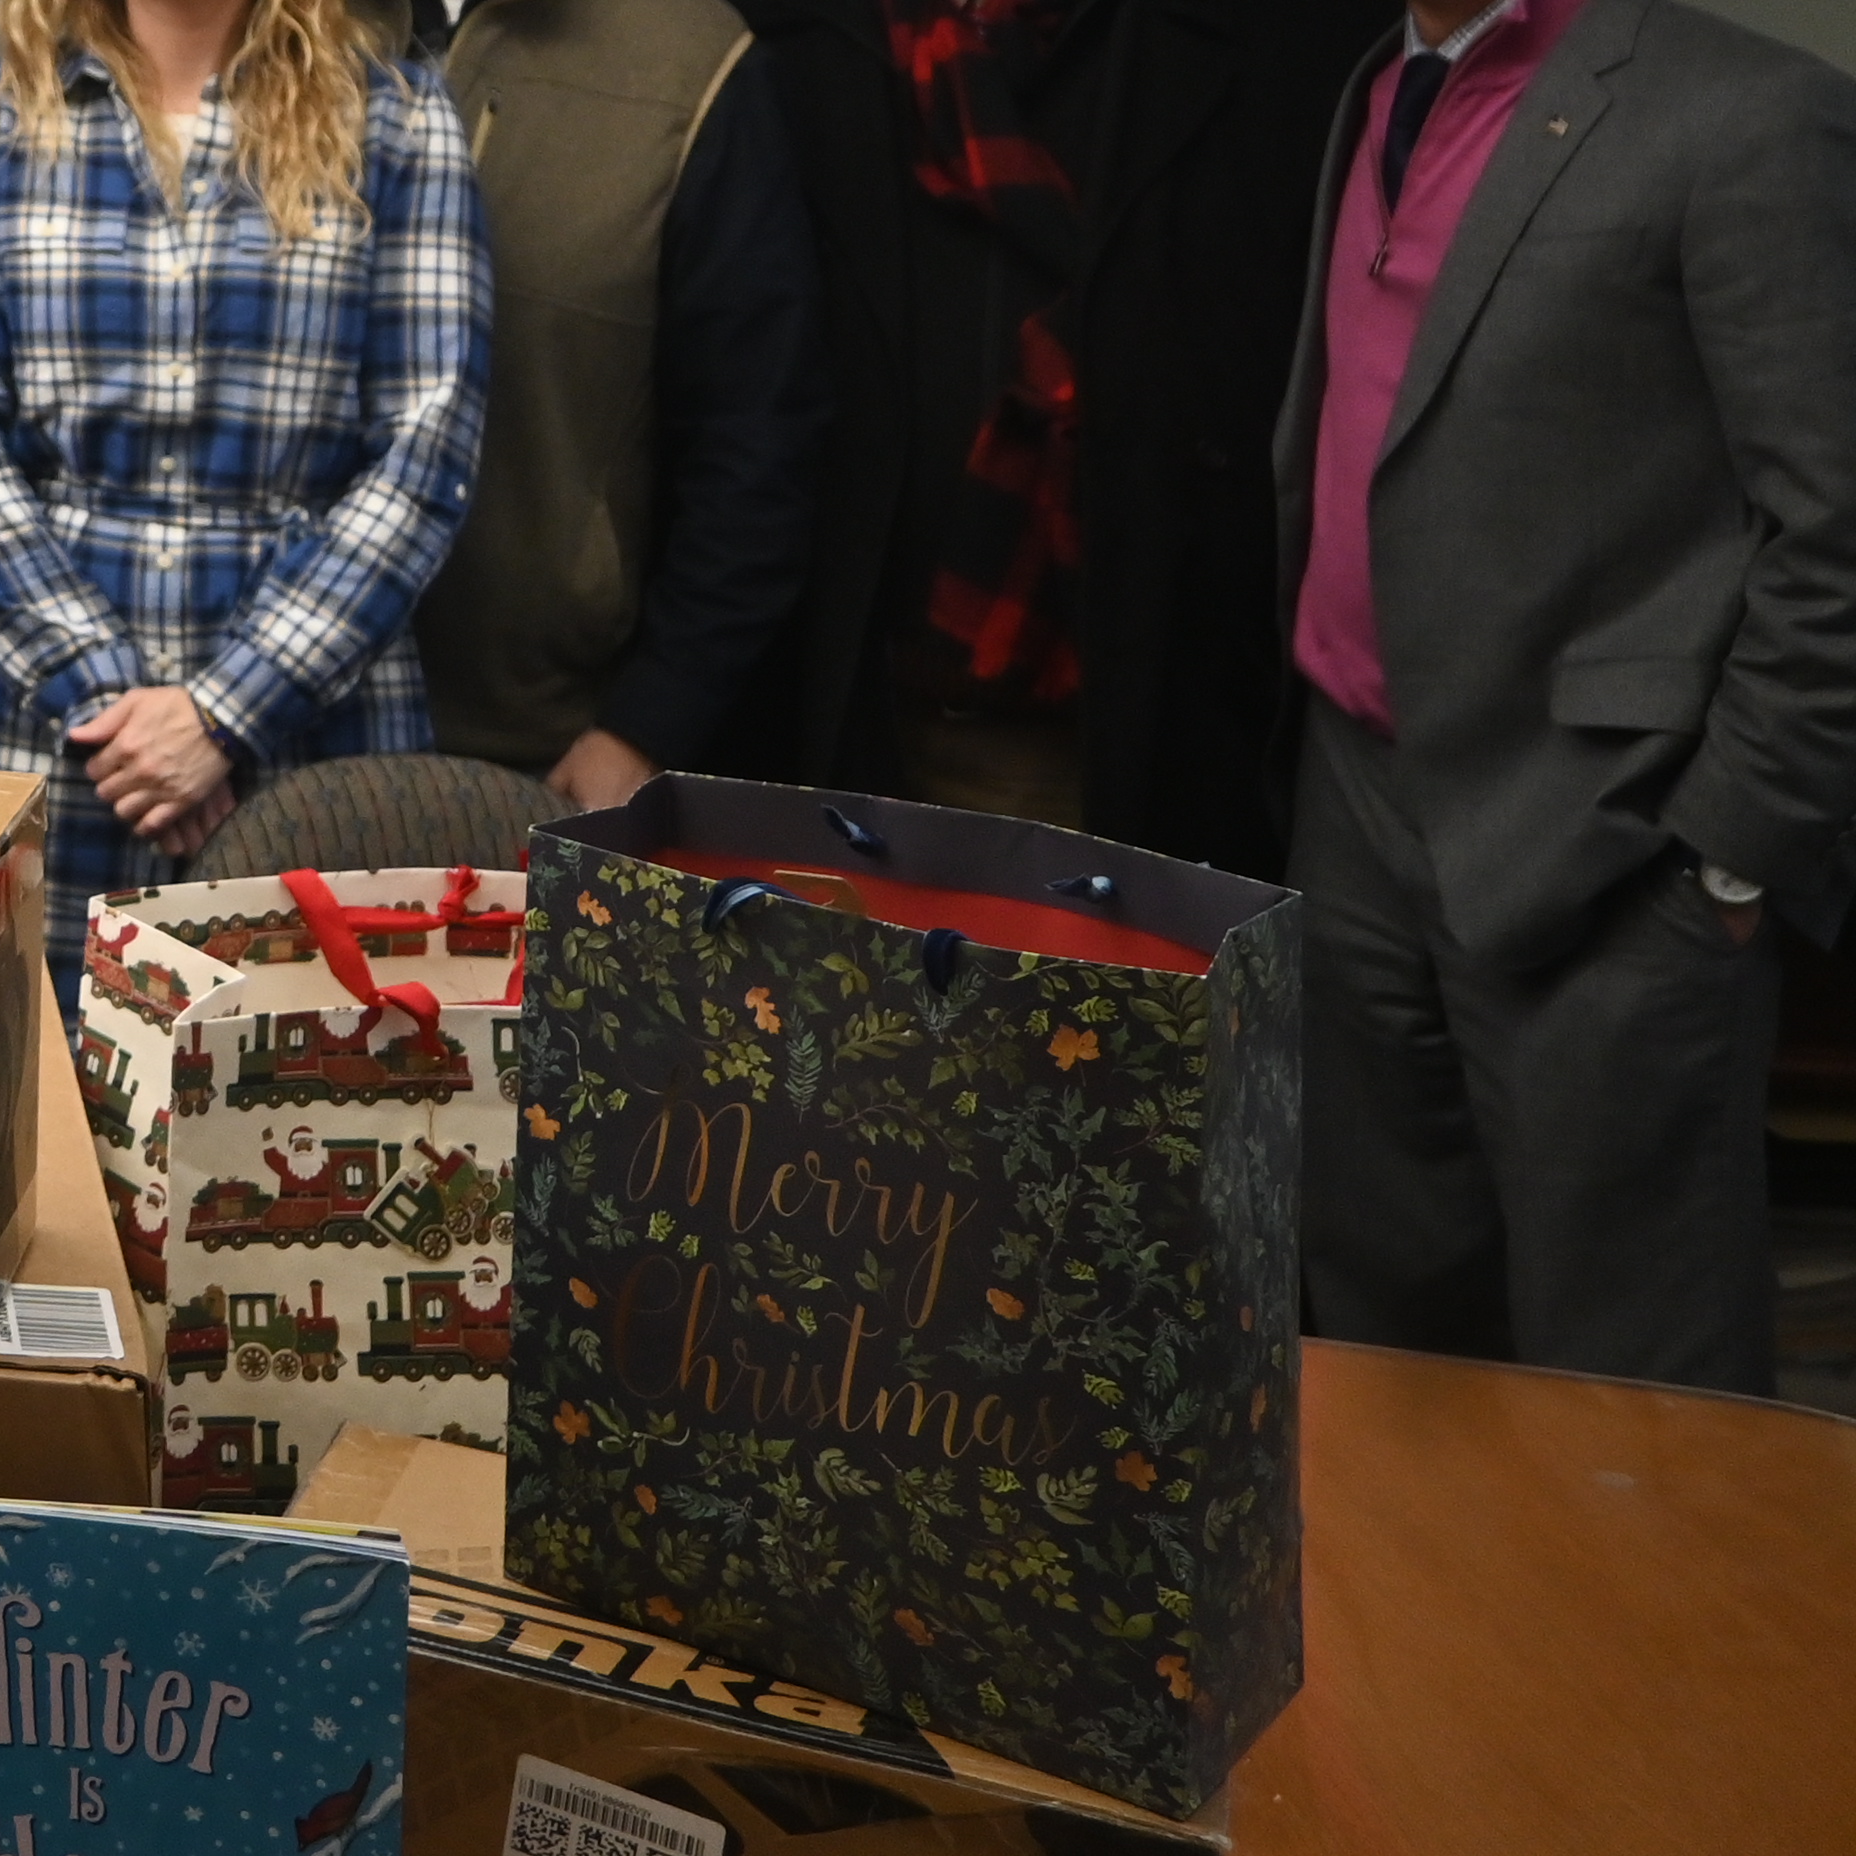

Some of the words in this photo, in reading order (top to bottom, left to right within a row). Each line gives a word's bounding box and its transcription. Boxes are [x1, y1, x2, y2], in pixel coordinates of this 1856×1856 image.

[624, 1063, 978, 1328] Merry
[611, 1254, 1079, 1468] Christmas
[407, 1580, 868, 1736] onka
